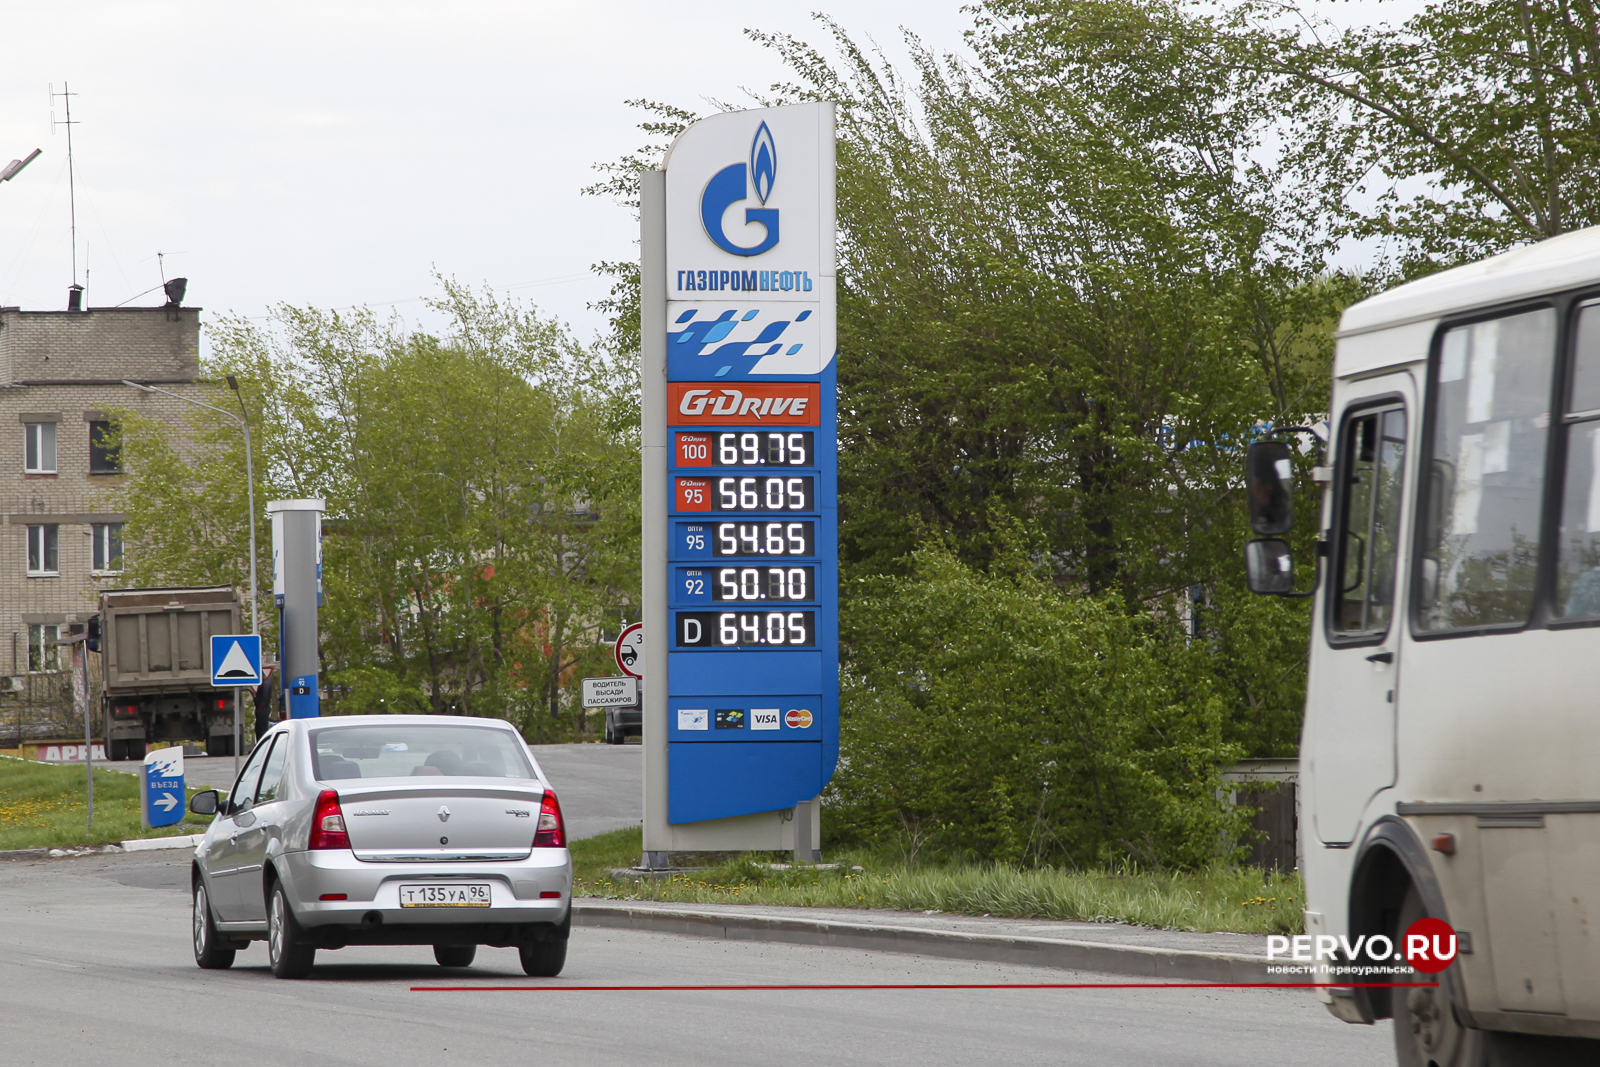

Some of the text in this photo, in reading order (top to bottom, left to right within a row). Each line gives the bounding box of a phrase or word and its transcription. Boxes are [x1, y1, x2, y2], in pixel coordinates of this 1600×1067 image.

[677, 270, 813, 292] ГАЗПРОМНЕФТЬ
[682, 433, 806, 465] 100 69.75
[684, 488, 703, 505] 95
[686, 523, 805, 555] 95 54.65
[685, 568, 806, 600] 92 50.70
[684, 613, 806, 645] D 64.05
[754, 714, 778, 724] VISA
[151, 781, 179, 789] ВЪЕЗД
[470, 886, 485, 898] 96
